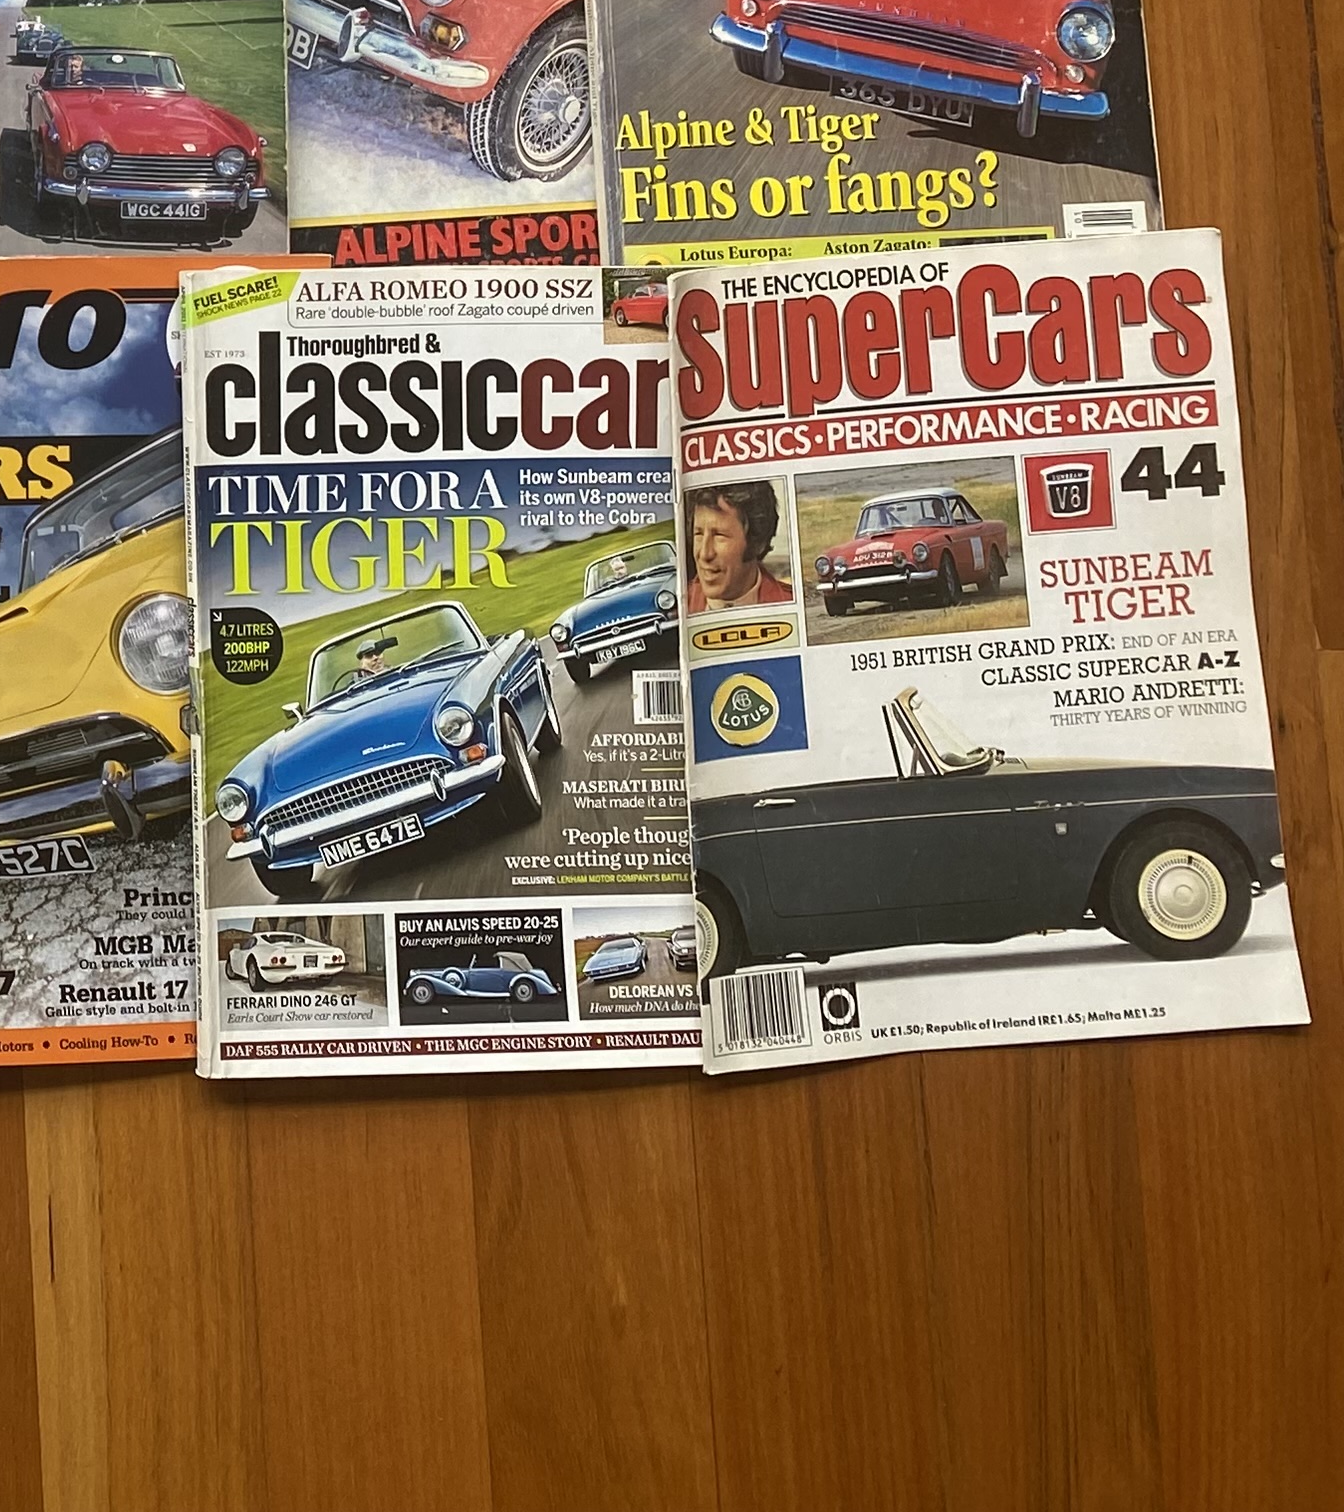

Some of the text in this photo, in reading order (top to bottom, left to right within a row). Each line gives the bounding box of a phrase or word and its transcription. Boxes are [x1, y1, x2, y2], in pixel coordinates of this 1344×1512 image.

[621, 151, 1001, 227] Fins or fangs?
[127, 202, 160, 218] WGC
[296, 279, 593, 303] ALFA ROMEO 1900 SSZ
[722, 262, 949, 299] THE ENCYCLOPEDIA OF
[209, 469, 508, 516] TIME FOR A
[1120, 444, 1225, 501] 44
[209, 516, 516, 597] TIGER
[1040, 550, 1213, 590] SUNBEAM
[1065, 584, 1195, 624] TIGER
[850, 633, 1116, 672] 1951 BRITISH GRAND PRIX:
[323, 816, 421, 865] NME 647E
[226, 993, 357, 1010] FERRARI DINO 246 GT
[824, 1030, 862, 1045] ORBIS
